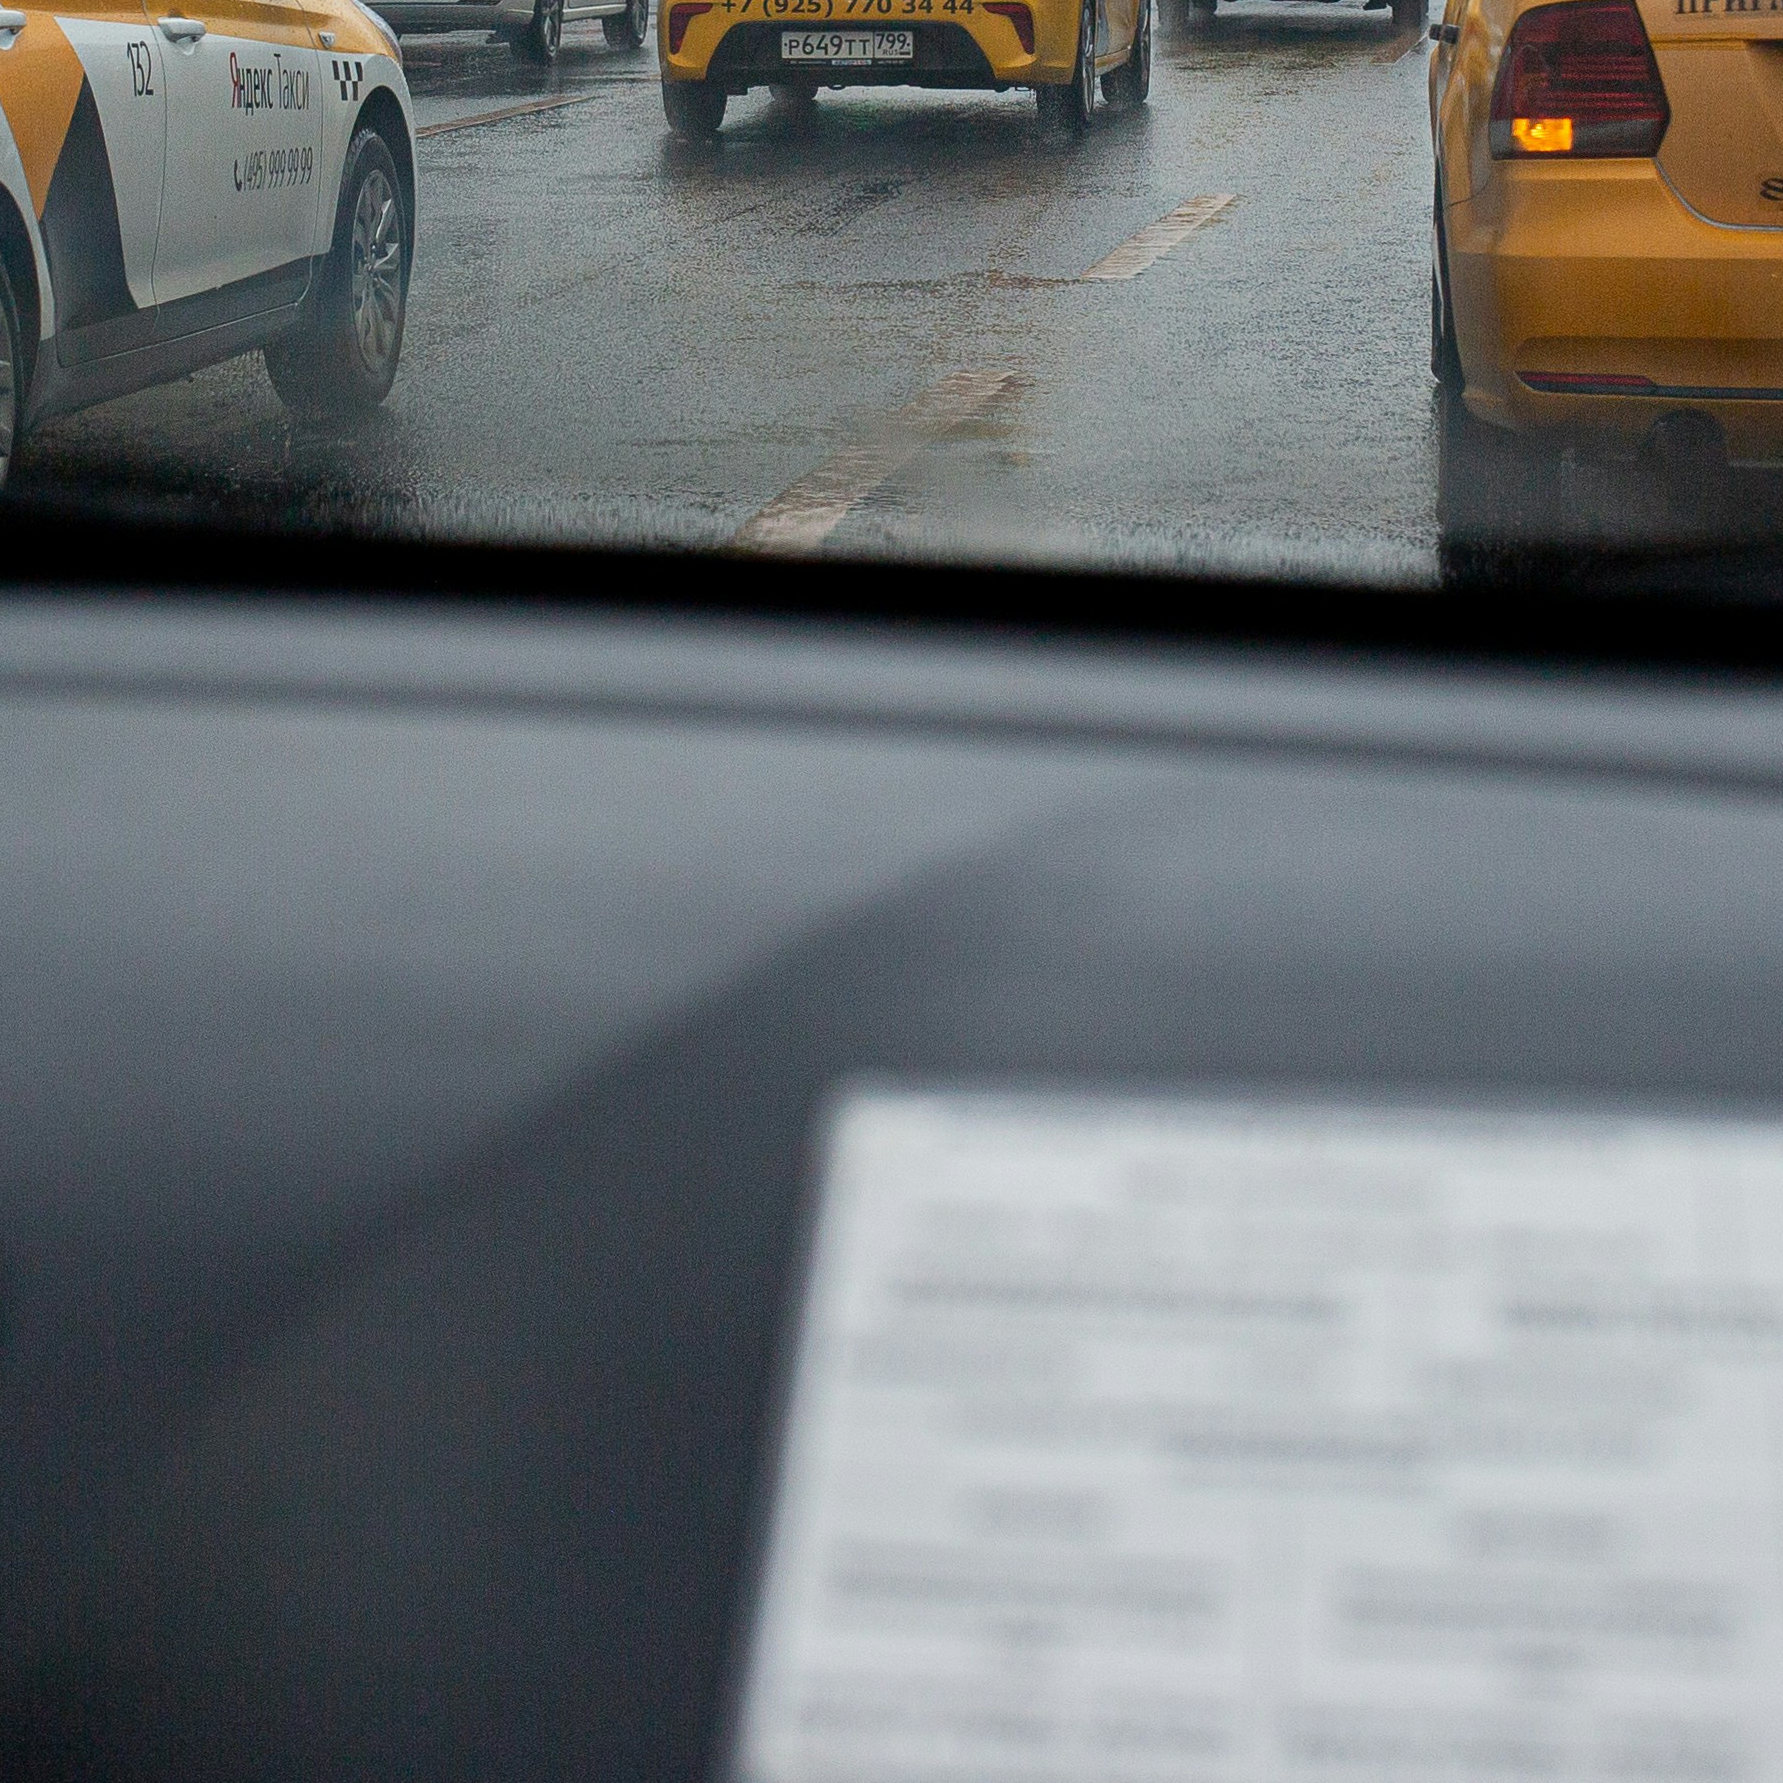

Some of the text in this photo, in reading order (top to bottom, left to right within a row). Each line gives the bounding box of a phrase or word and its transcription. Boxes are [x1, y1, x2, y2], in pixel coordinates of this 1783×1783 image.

[127, 41, 154, 97] 132
[788, 32, 907, 56] Р649ТТ 799
[229, 51, 310, 116] Яндекс Такси
